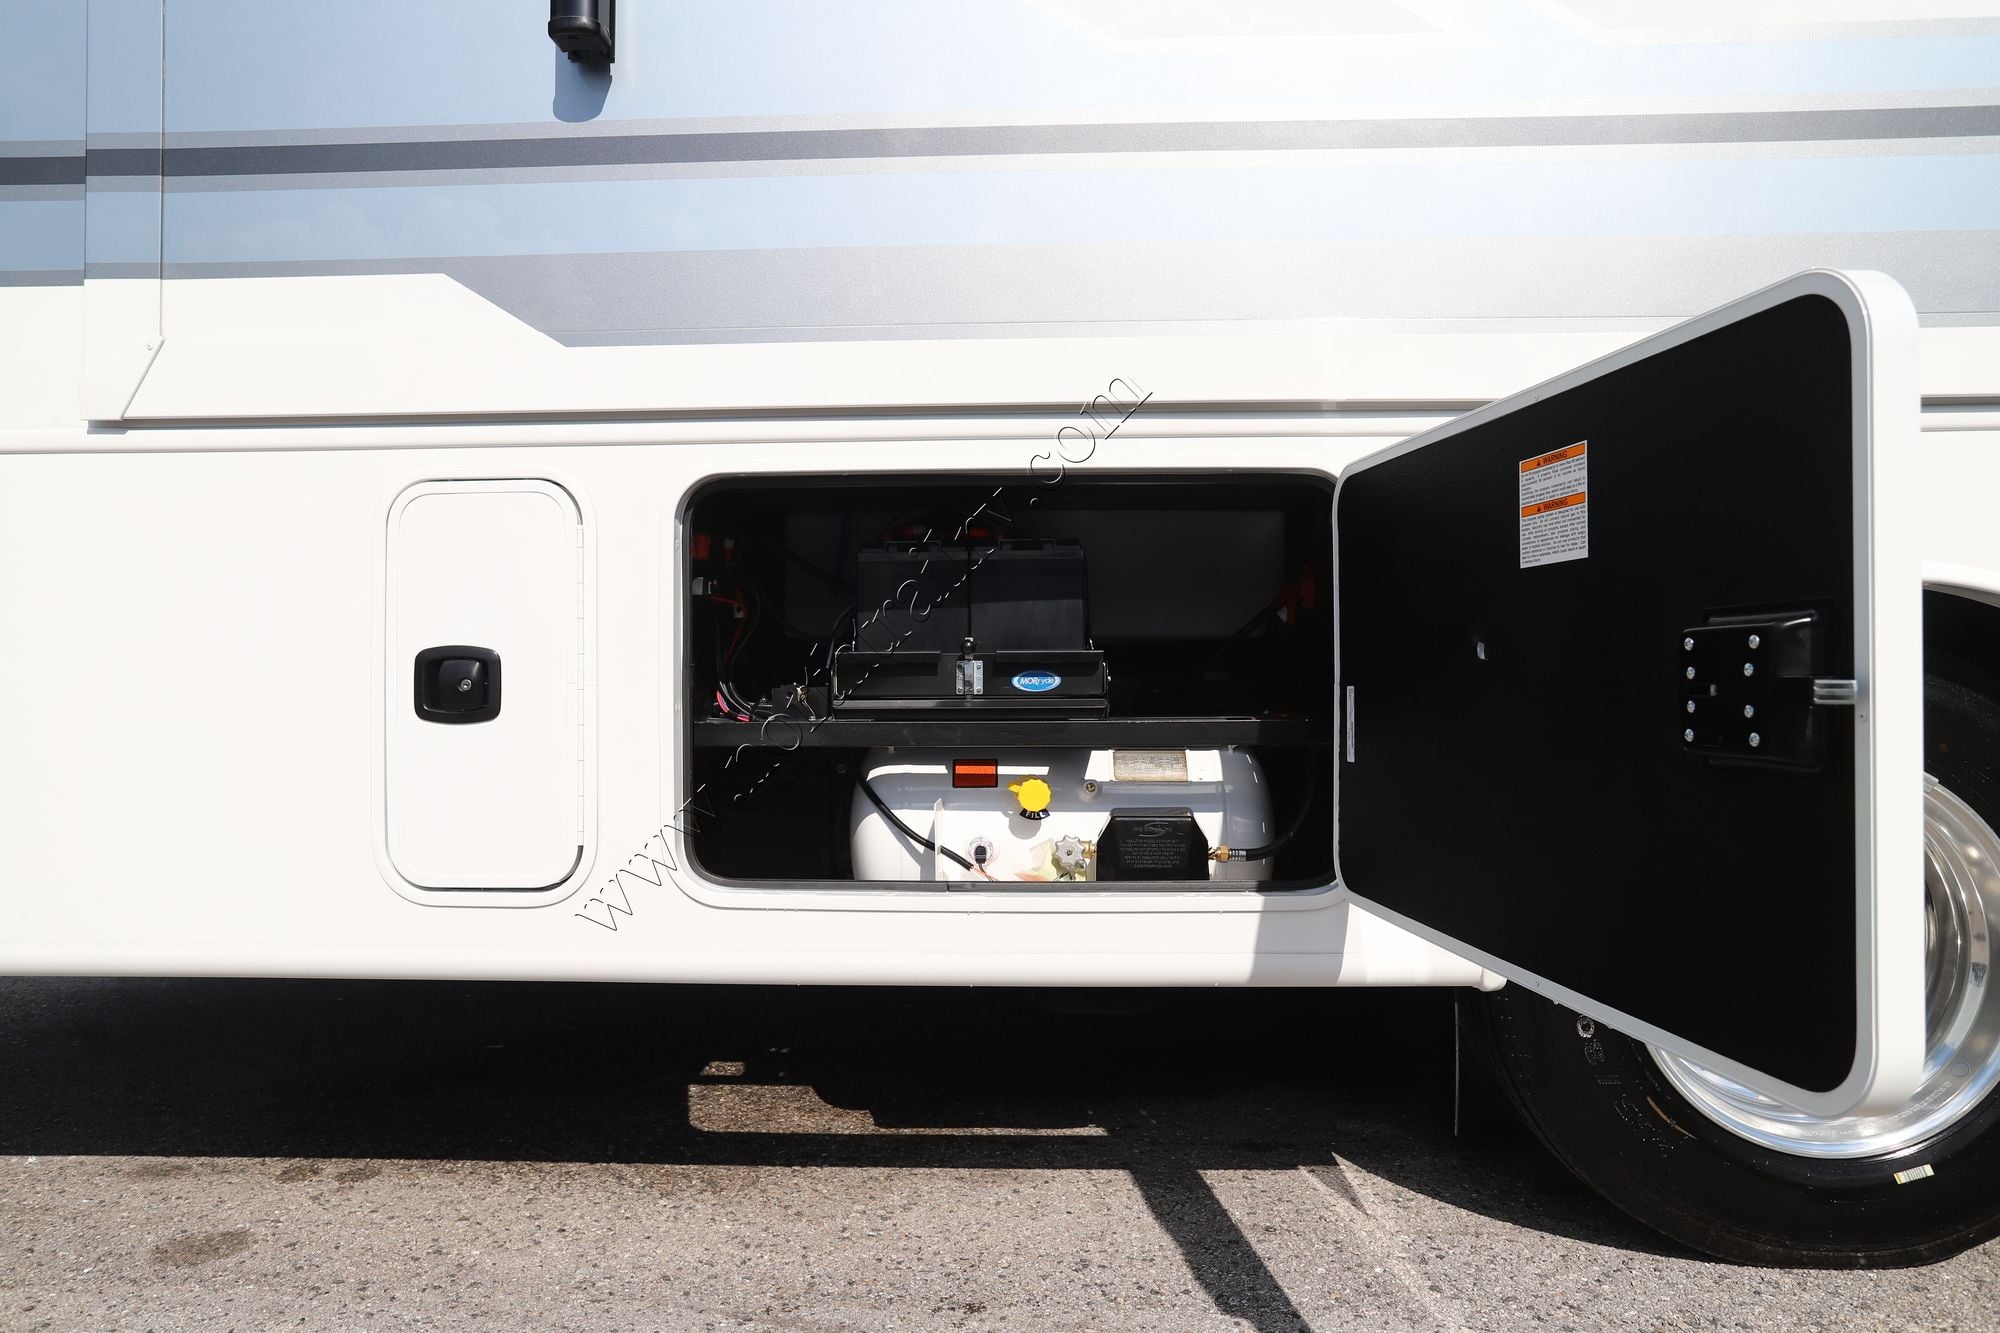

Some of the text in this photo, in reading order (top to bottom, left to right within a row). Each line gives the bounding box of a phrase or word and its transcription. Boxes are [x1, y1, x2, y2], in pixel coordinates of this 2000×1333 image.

[1543, 451, 1568, 464] WARNING
[1543, 498, 1568, 511] WARNING
[1025, 811, 1046, 819] FILL
